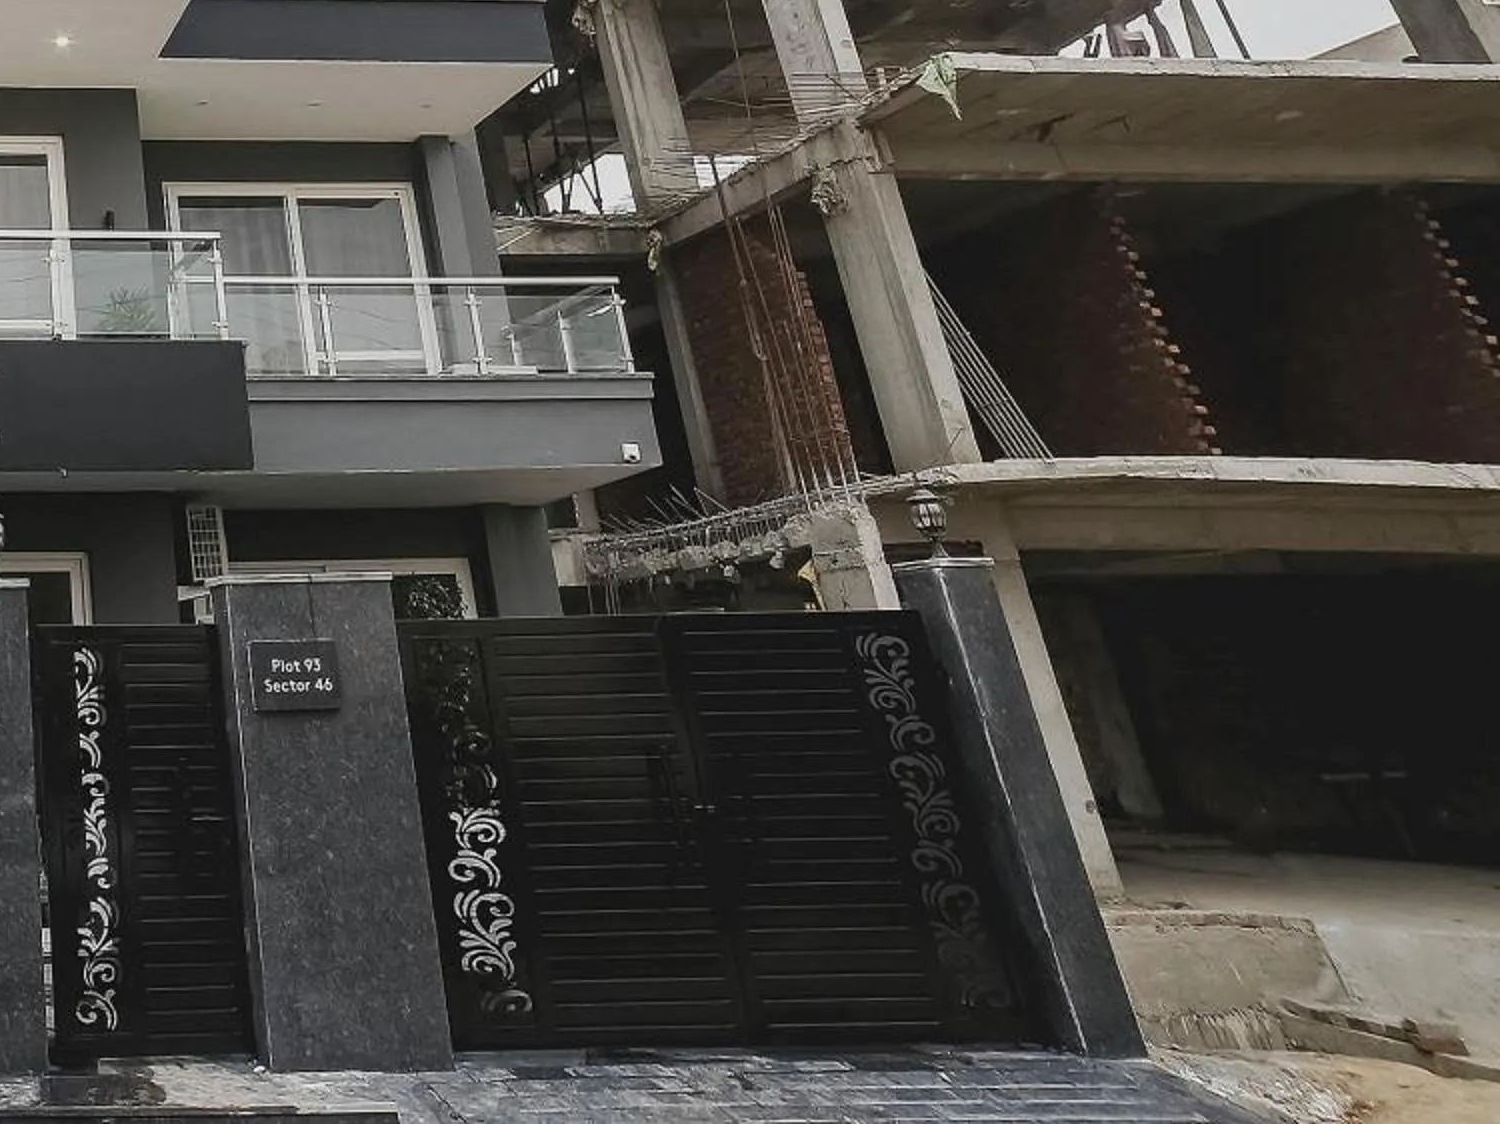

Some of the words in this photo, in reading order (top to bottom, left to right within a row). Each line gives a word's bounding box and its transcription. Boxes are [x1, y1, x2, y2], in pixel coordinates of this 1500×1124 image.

[271, 659, 301, 673] Plot
[303, 657, 321, 673] 93
[264, 678, 311, 693] Sector
[314, 677, 333, 692] 46
